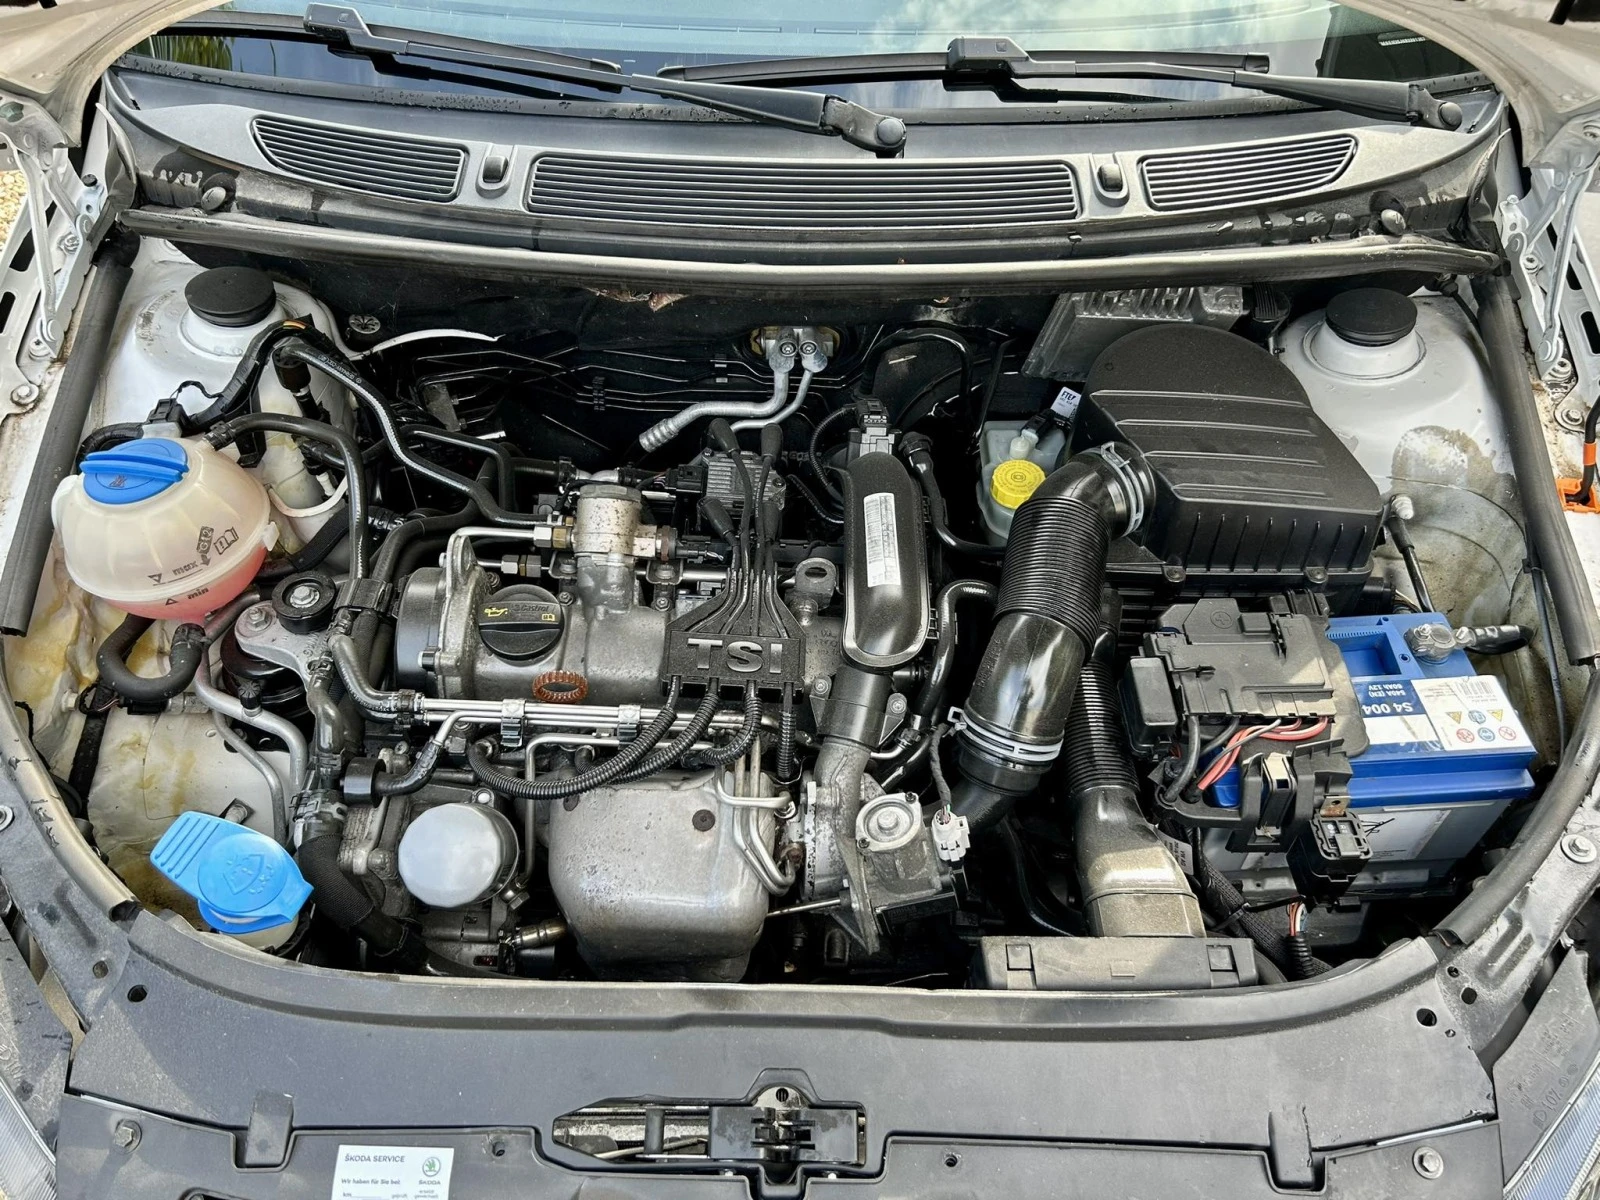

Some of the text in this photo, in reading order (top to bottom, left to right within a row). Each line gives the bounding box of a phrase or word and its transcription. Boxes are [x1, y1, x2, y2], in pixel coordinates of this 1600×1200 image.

[200, 527, 213, 550] G12
[172, 561, 198, 576] max
[187, 588, 209, 600] min
[687, 638, 782, 674] TSI
[1362, 702, 1414, 714] S4 004
[345, 1152, 371, 1162] ŠKODA
